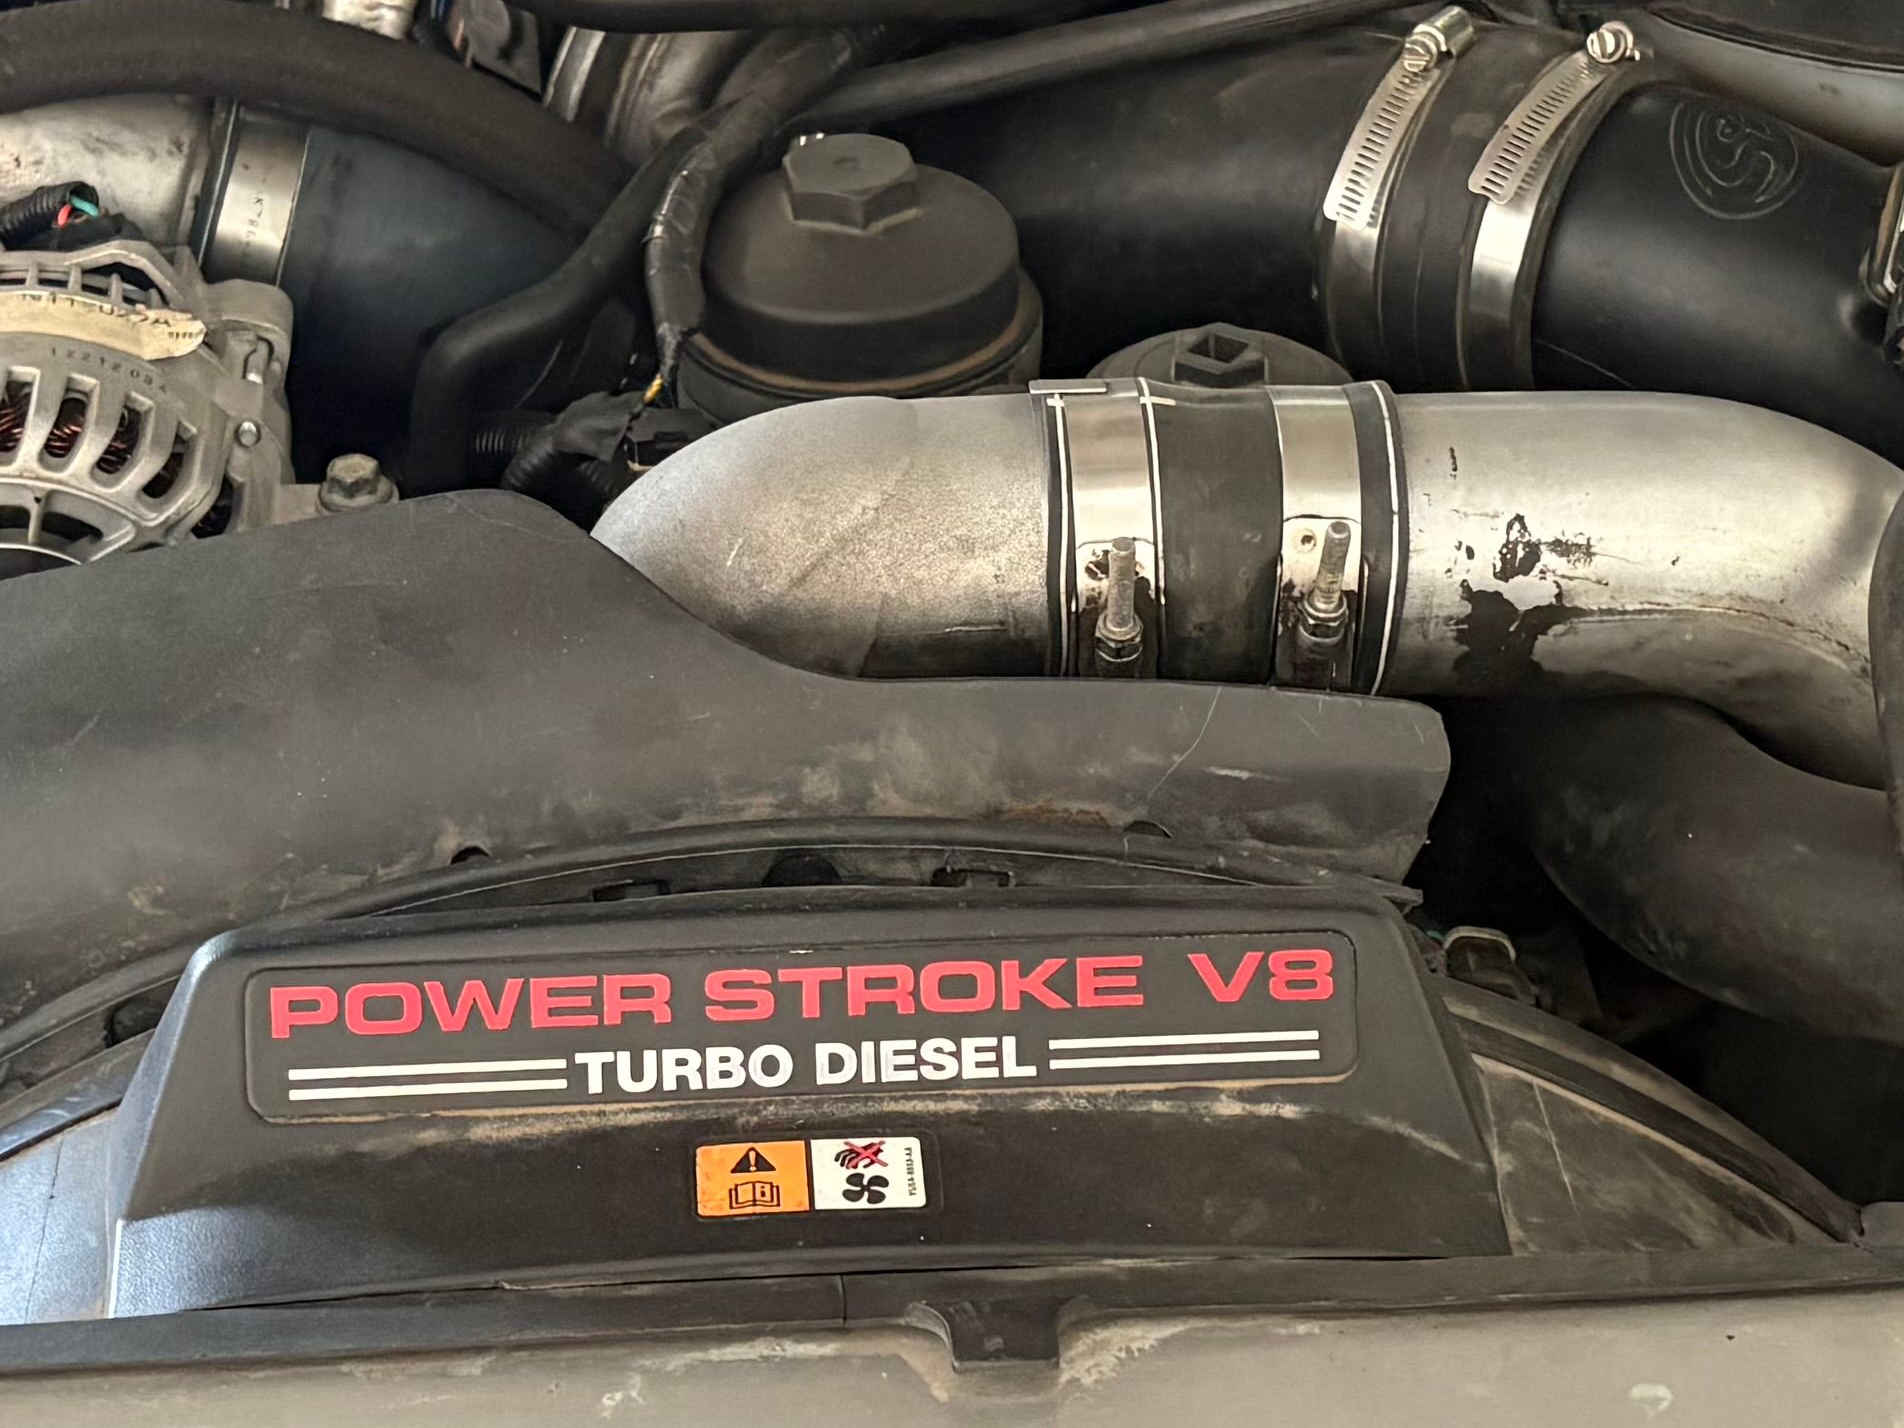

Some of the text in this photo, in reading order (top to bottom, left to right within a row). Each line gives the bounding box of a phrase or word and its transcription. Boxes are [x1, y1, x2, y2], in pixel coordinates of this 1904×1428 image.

[270, 948, 1336, 1040] POWER STROKE V8
[574, 1035, 1043, 1096] TURBO DIESEL
